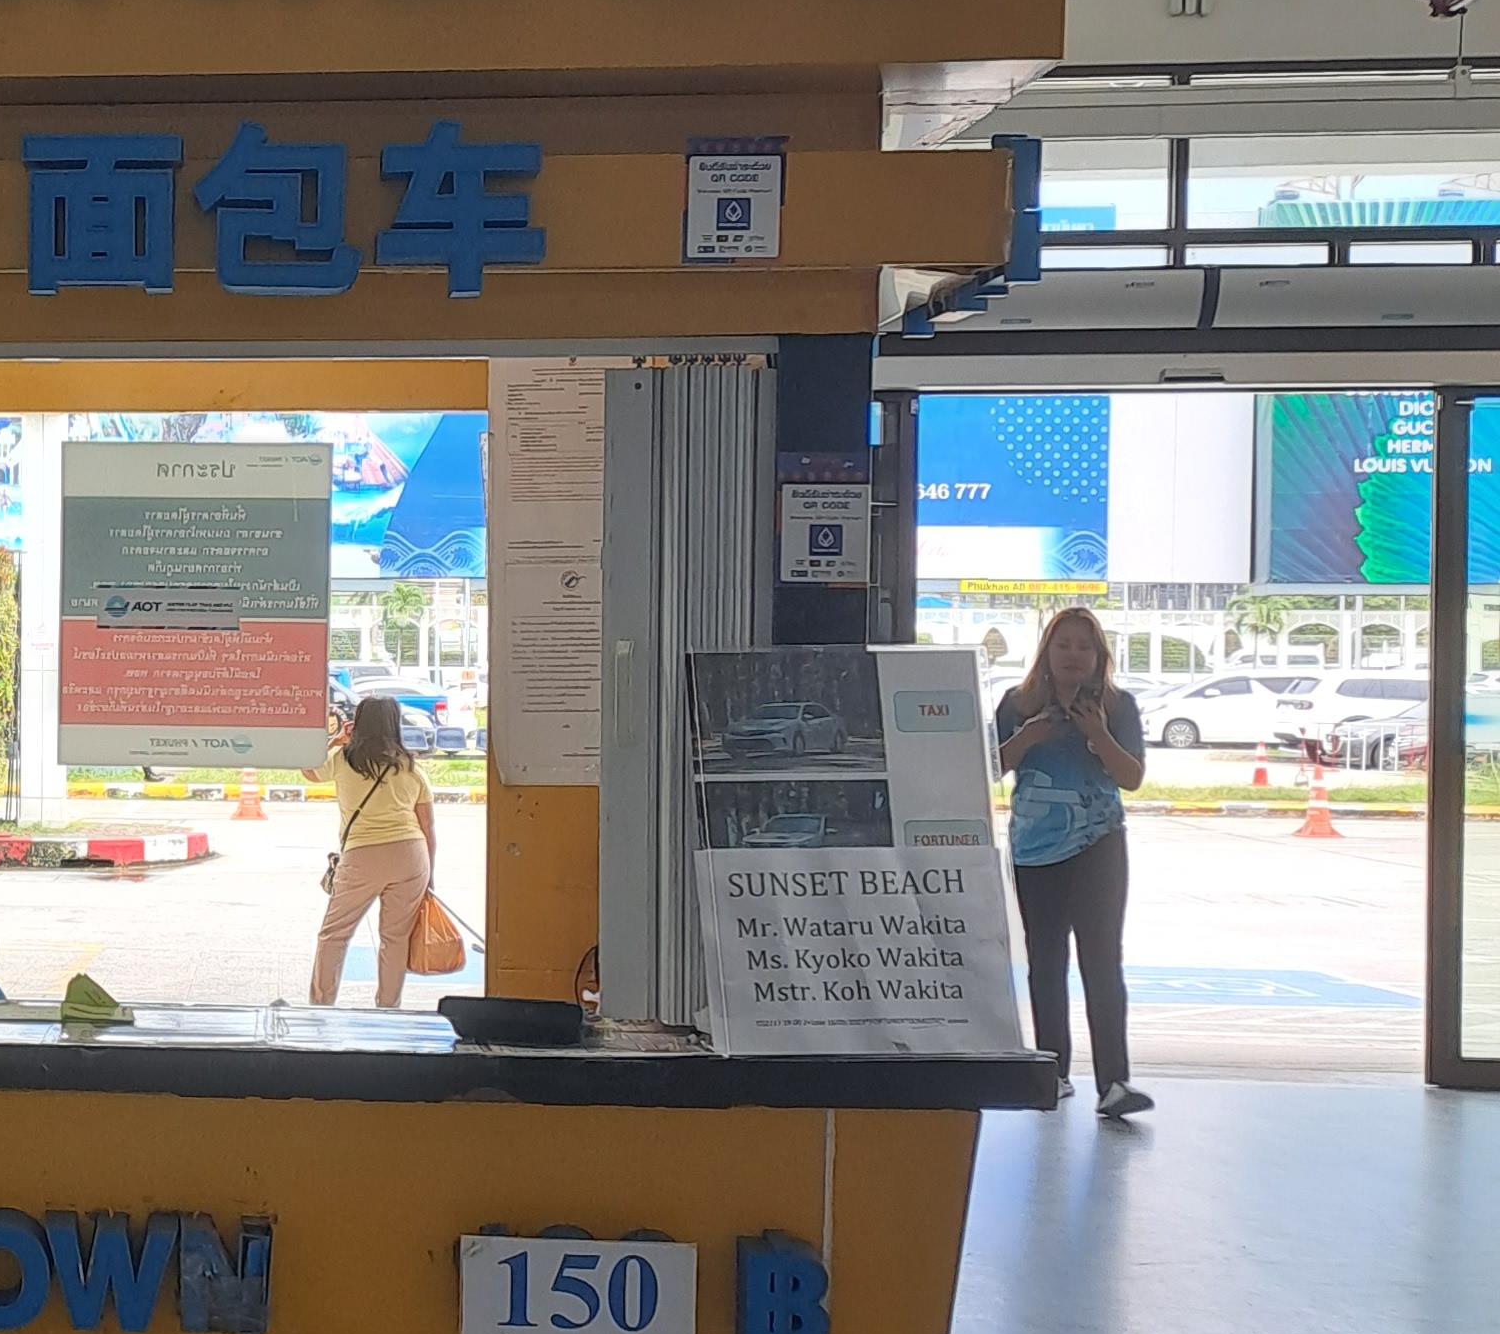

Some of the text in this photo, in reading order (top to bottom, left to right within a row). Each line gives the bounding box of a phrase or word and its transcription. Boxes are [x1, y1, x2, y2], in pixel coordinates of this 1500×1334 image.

[730, 174, 759, 182] CODE
[1399, 400, 1435, 416] DIO
[1392, 419, 1434, 435] GUC
[1354, 458, 1407, 473] LOUIS
[954, 483, 991, 499] 777
[131, 601, 163, 612] AOT
[918, 703, 950, 717] TAXI
[913, 833, 980, 846] FORTUNER
[728, 868, 965, 898] SUNSET BEACH
[737, 914, 967, 939] Mr. Wataru Wakita
[747, 946, 964, 974] Ms. Kyoko Wakita
[754, 979, 964, 1003] Mstr. Koh Wakita
[496, 1252, 660, 1334] 150
